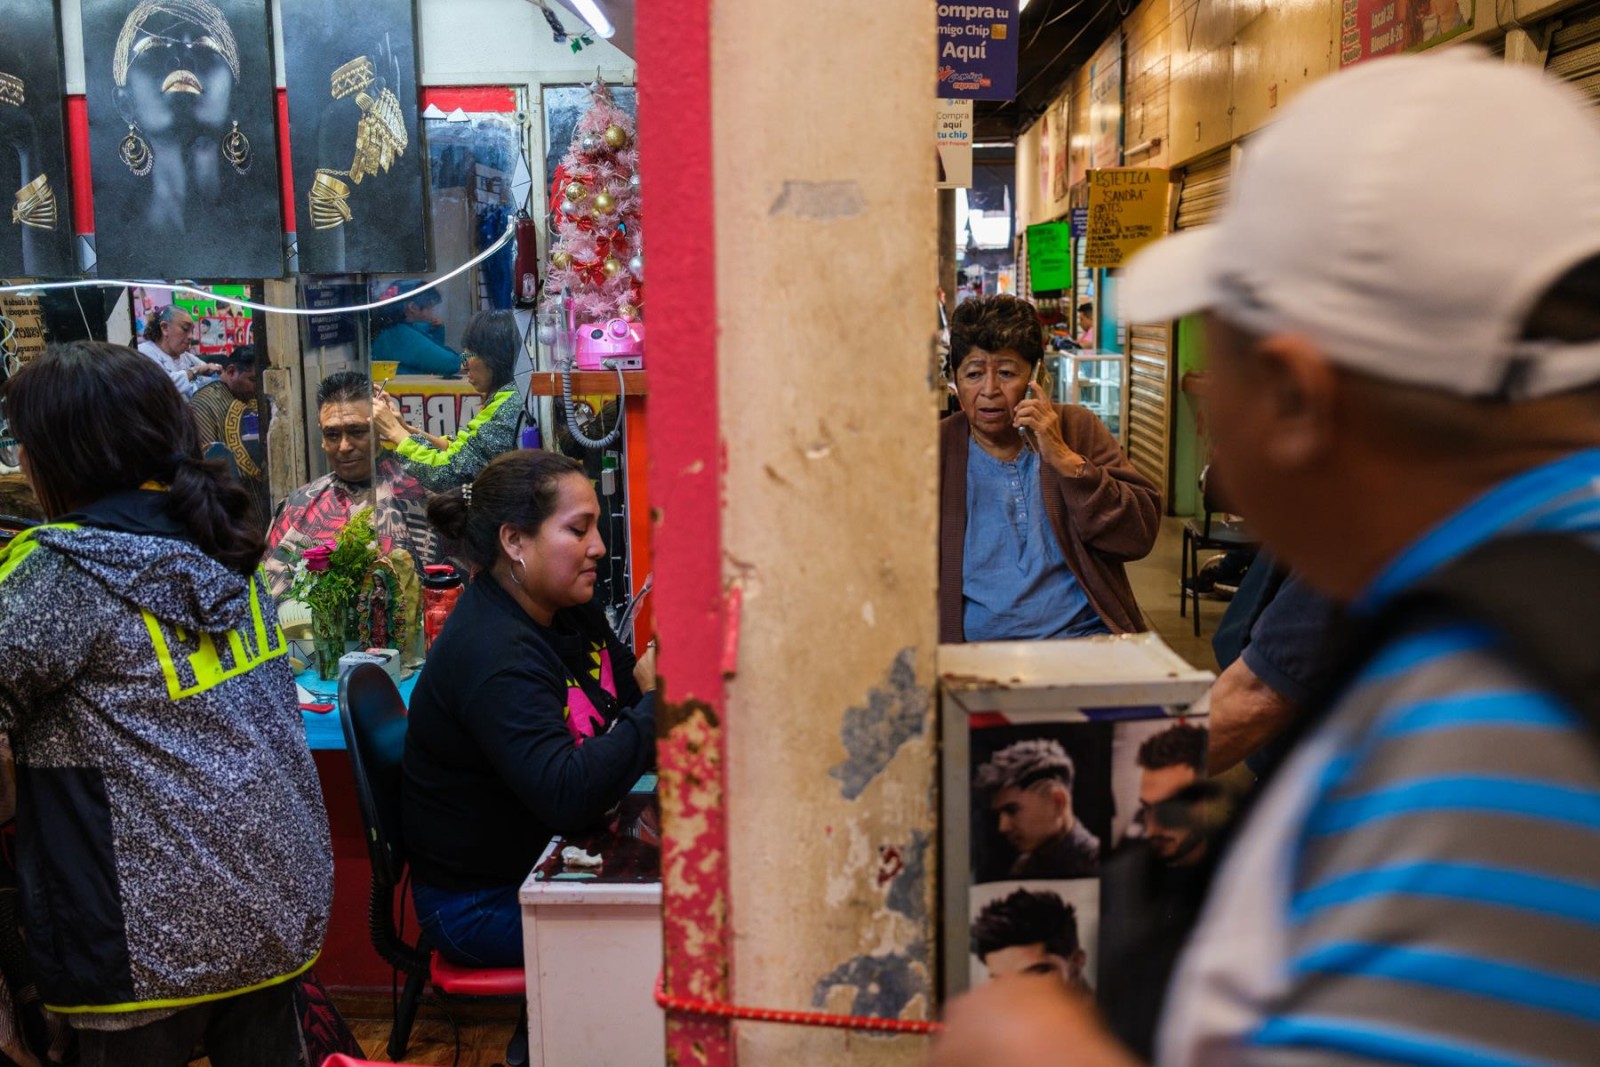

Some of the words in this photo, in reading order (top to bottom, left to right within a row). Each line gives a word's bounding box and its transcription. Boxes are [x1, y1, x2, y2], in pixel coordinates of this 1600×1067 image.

[936, 5, 995, 20] ompra
[996, 8, 1009, 18] tu
[937, 23, 964, 37] migo
[965, 24, 990, 38] Chip
[942, 41, 987, 63] Aquí
[937, 112, 970, 122] Compra
[943, 121, 962, 131] aquí
[949, 131, 968, 140] chip
[1095, 171, 1151, 187] ESTETICA
